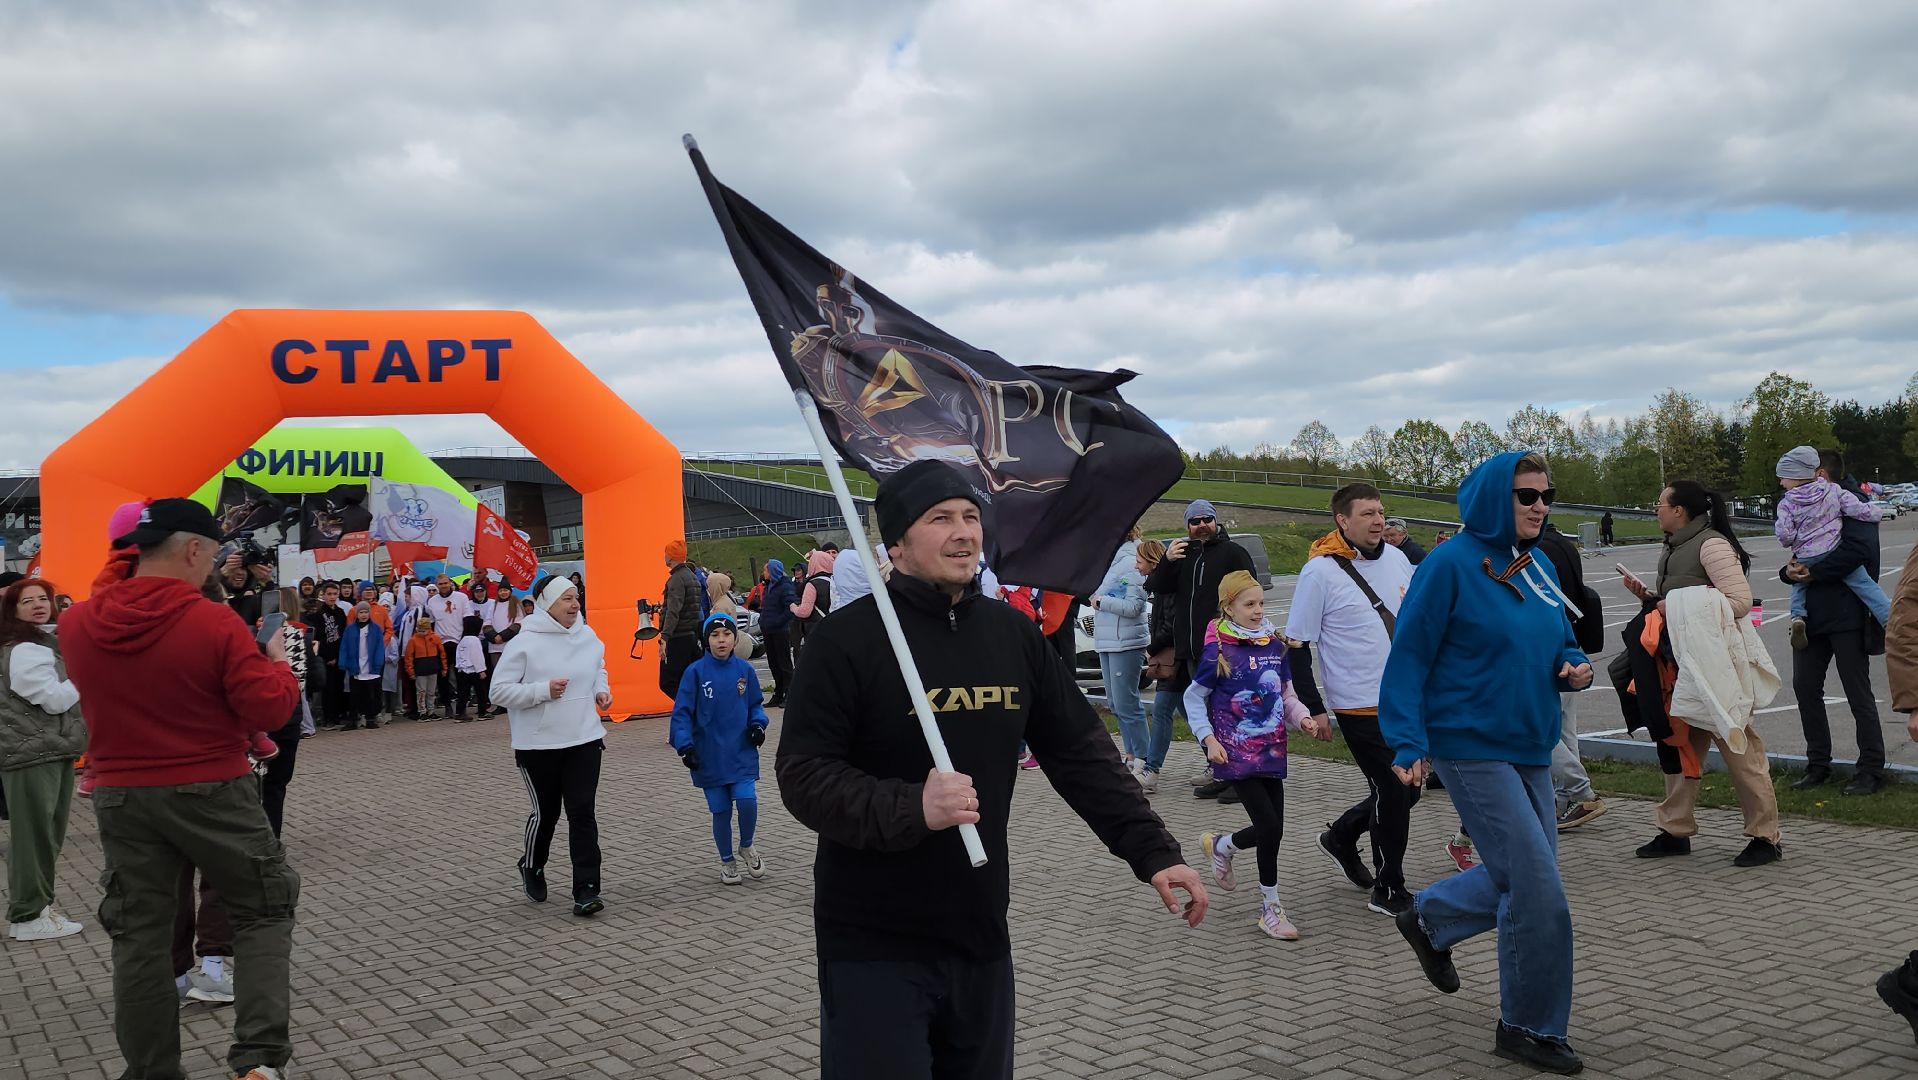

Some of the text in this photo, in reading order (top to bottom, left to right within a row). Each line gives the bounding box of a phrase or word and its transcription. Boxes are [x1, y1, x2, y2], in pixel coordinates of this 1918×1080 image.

[270, 338, 512, 384] СТАРТ
[236, 447, 384, 477] ФИНИШ
[703, 687, 714, 699] 12
